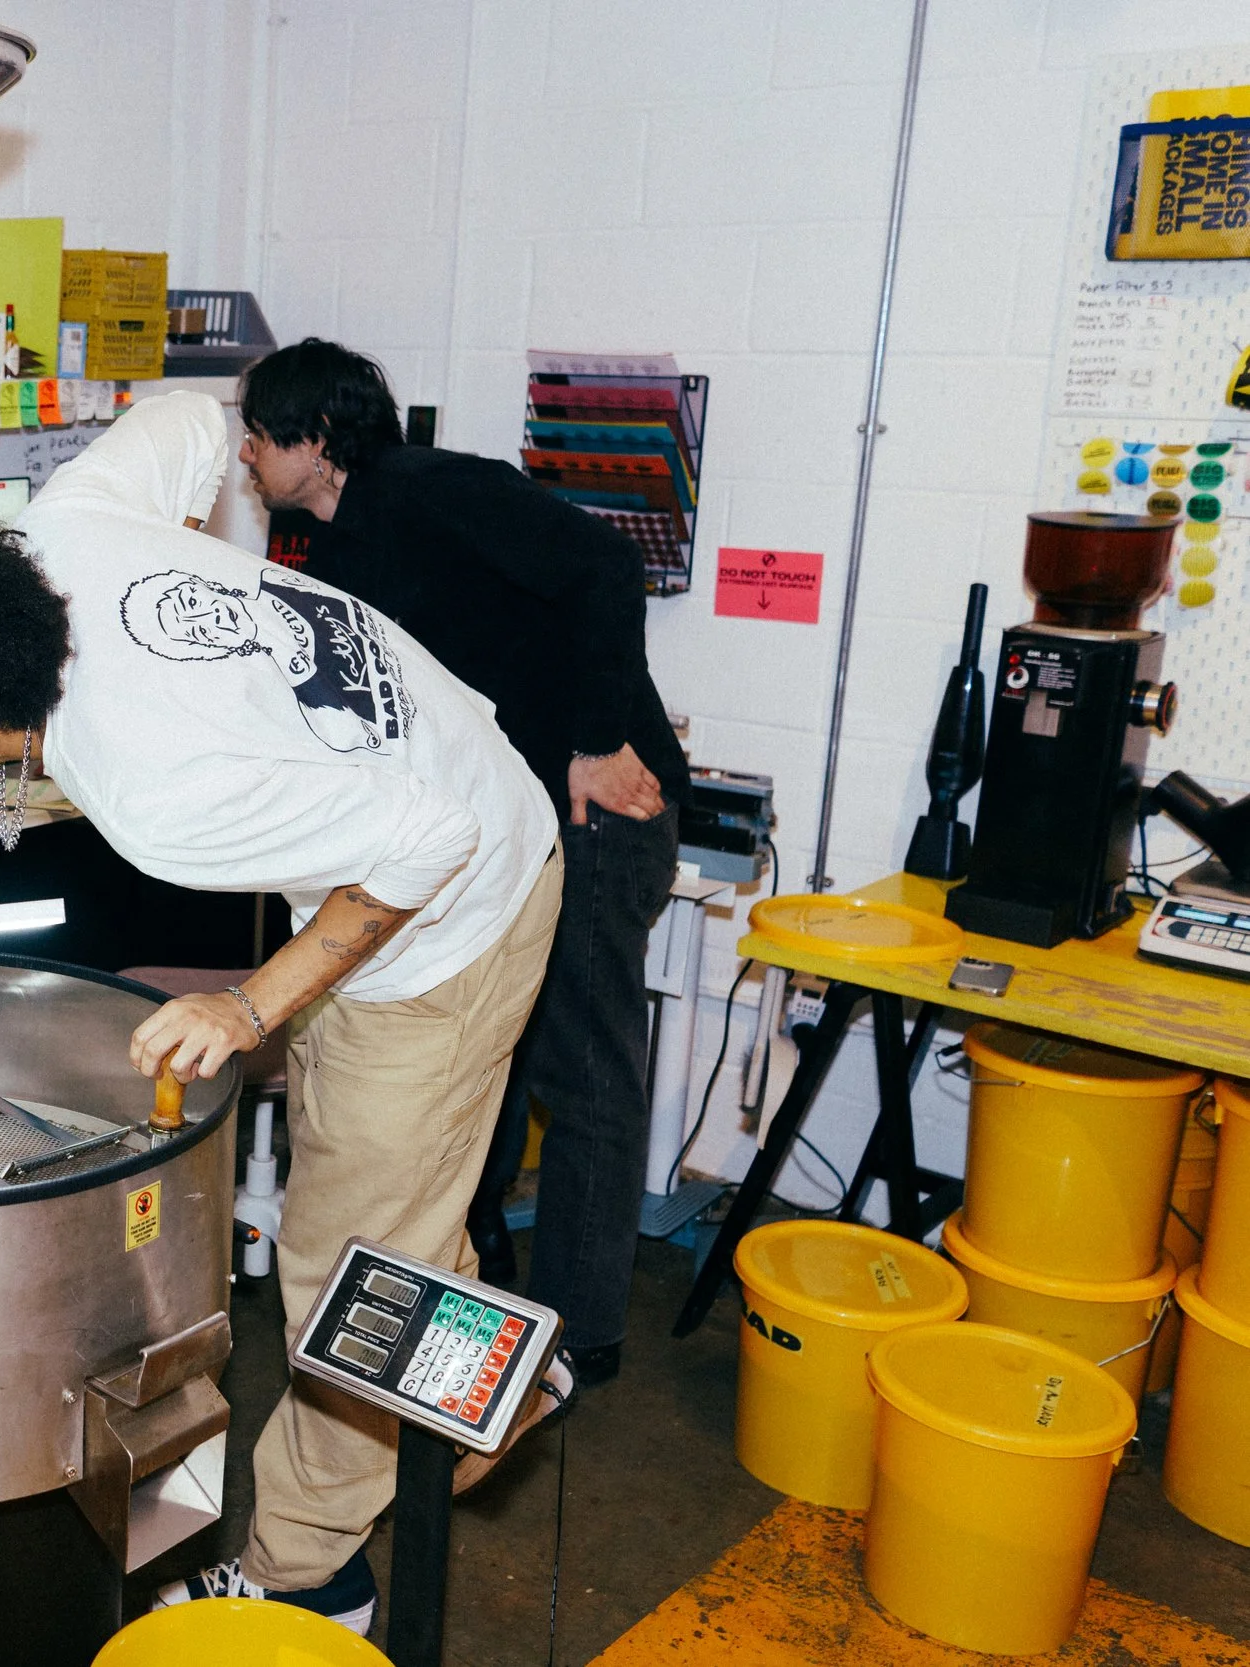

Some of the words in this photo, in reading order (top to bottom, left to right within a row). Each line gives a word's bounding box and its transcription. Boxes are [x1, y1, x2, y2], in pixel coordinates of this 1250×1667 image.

[1224, 131, 1250, 229] HINGS
[1201, 202, 1224, 230] IN
[719, 568, 738, 577] DO
[740, 569, 766, 579] NOT
[770, 571, 815, 582] TOUCH
[315, 604, 372, 692] Kathy's
[349, 597, 388, 676] COFEE
[379, 680, 399, 739] BAD
[445, 1295, 459, 1310] M1
[464, 1303, 481, 1318] M2
[367, 1335, 380, 1344] PRICE
[455, 1319, 471, 1334] M4
[476, 1328, 493, 1342] M5
[741, 1302, 802, 1351] AD
[431, 1329, 440, 1341] 1
[470, 1345, 482, 1358] 3
[421, 1346, 433, 1358] 4
[441, 1354, 453, 1366] 5
[461, 1363, 474, 1375] 6
[412, 1361, 425, 1373] 7
[431, 1371, 444, 1383] 8
[452, 1380, 464, 1391] 9
